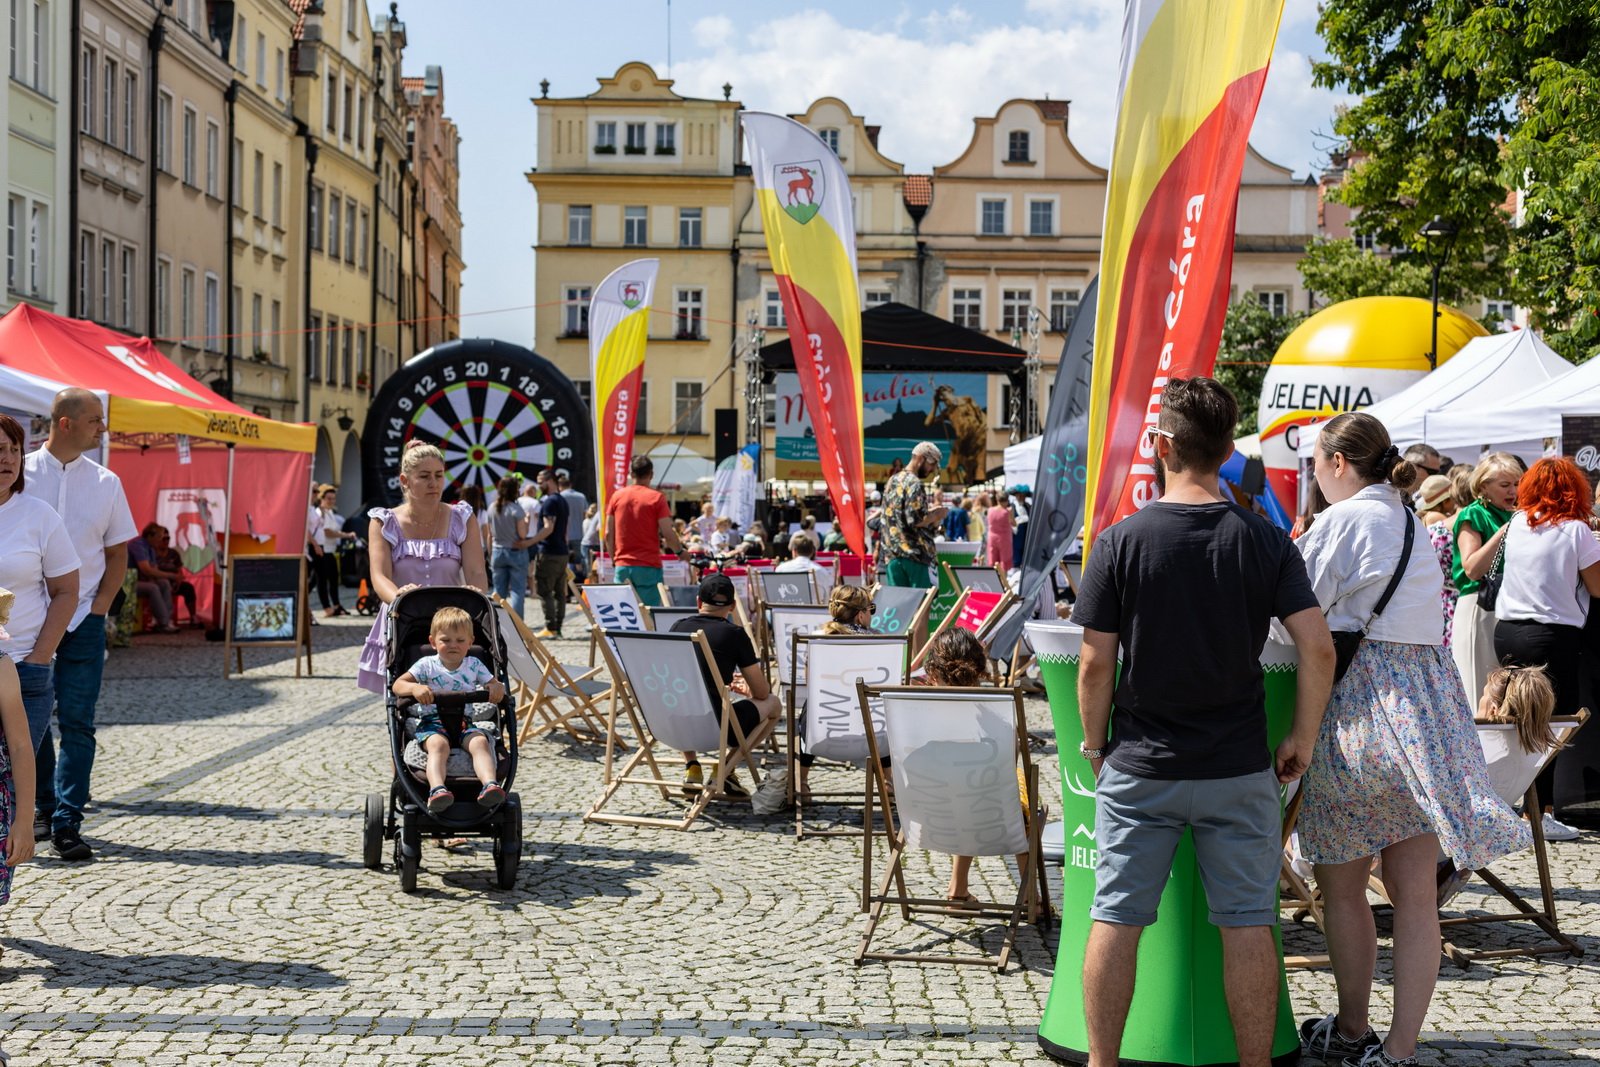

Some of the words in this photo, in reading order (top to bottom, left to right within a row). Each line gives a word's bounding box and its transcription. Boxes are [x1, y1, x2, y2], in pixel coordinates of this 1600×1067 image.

[1163, 194, 1205, 330] Góra
[443, 366, 456, 382] 5
[465, 362, 489, 377] 20
[500, 367, 511, 381] 1
[414, 375, 437, 396] 12
[518, 375, 539, 397] 18
[398, 397, 413, 412] 9
[540, 398, 555, 411] 4
[1268, 383, 1374, 412] JELENIA
[613, 389, 629, 436] Góra
[387, 417, 405, 440] 14
[551, 416, 569, 439] 13
[384, 446, 399, 467] 11
[557, 447, 572, 460] 6
